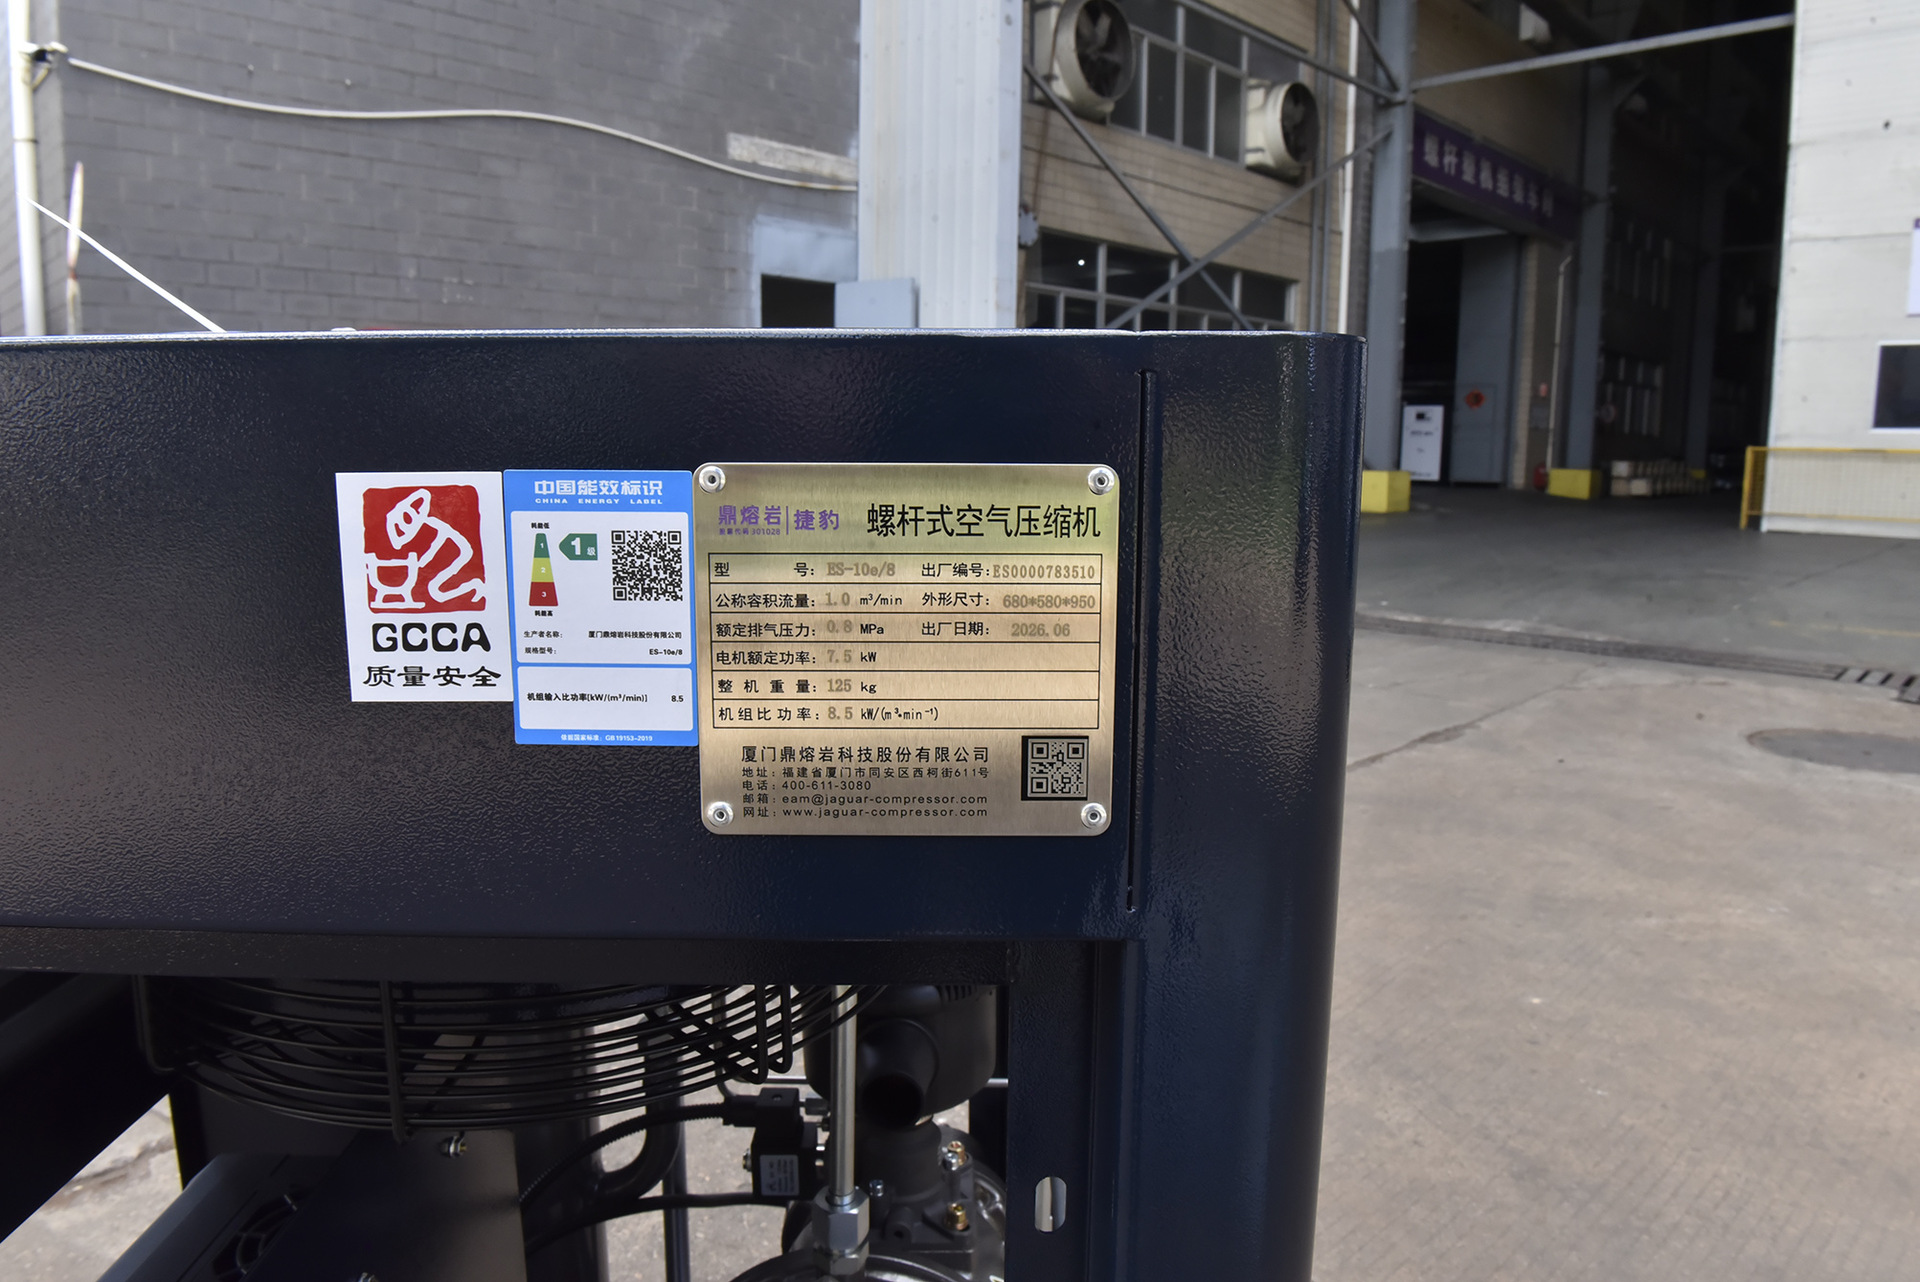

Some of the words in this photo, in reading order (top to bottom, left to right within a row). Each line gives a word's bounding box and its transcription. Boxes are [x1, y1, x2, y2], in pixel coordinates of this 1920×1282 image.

[534, 480, 663, 496] 中国能效标识
[718, 504, 782, 526] 鼎熔岩
[794, 509, 840, 531] 捷豹
[867, 504, 1101, 538] 螺杆式空气压缩机
[752, 528, 780, 536] 301028
[826, 562, 896, 578] ES-10e/8
[992, 564, 1096, 580] ES0000783510
[825, 592, 850, 607] 1.0
[588, 631, 682, 639] 厦门鼎熔岩科技股份有限公司
[826, 620, 852, 635] 0.8
[860, 624, 884, 636] MPa
[1011, 623, 1070, 638] 2026.06
[372, 622, 491, 652] GCCA
[649, 648, 683, 656] ES-10e/8
[826, 650, 852, 664] 7.5
[860, 652, 877, 663] kW
[363, 665, 502, 687] 质量安全
[827, 679, 852, 693] 125
[860, 680, 877, 695] kg
[827, 706, 853, 720] 8.5
[741, 746, 990, 763] 厦门鼎熔岩科技股份有限公司
[782, 767, 990, 779] 福建省厦门市同安区西柯街611号
[782, 781, 871, 791] 400-611-3080
[782, 794, 988, 806] eam@jaguar-compressor.com
[782, 808, 988, 819] www.jaguar-compressor.com
